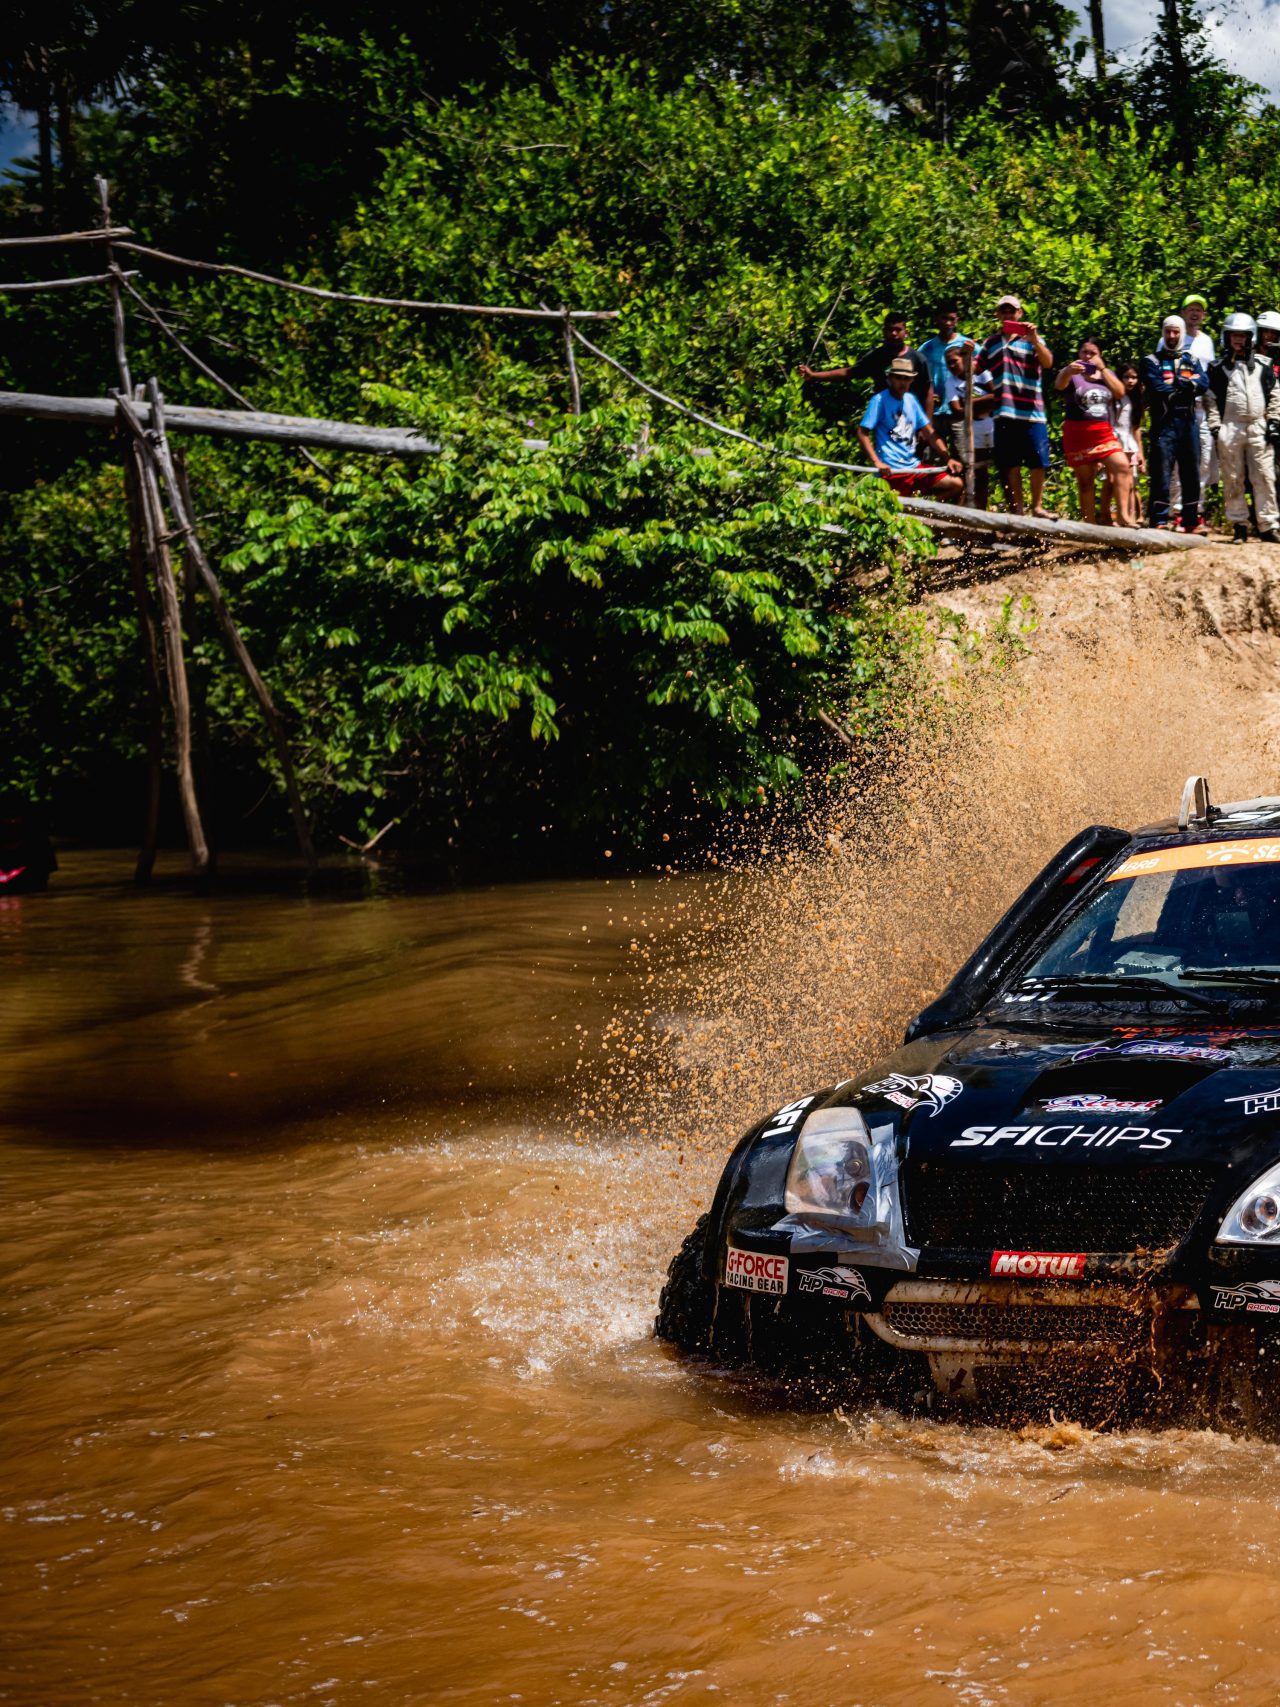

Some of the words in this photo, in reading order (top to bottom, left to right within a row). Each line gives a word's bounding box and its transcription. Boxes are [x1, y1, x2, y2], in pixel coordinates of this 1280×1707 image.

[950, 1125, 1184, 1150] SFICHIPS
[728, 1251, 786, 1280] G-FORCE
[994, 1254, 1081, 1276] MOTUL
[757, 1278, 785, 1294] GEAR
[799, 1275, 824, 1292] HP
[1214, 1291, 1247, 1309] HP
[1246, 1302, 1280, 1314] RACING
